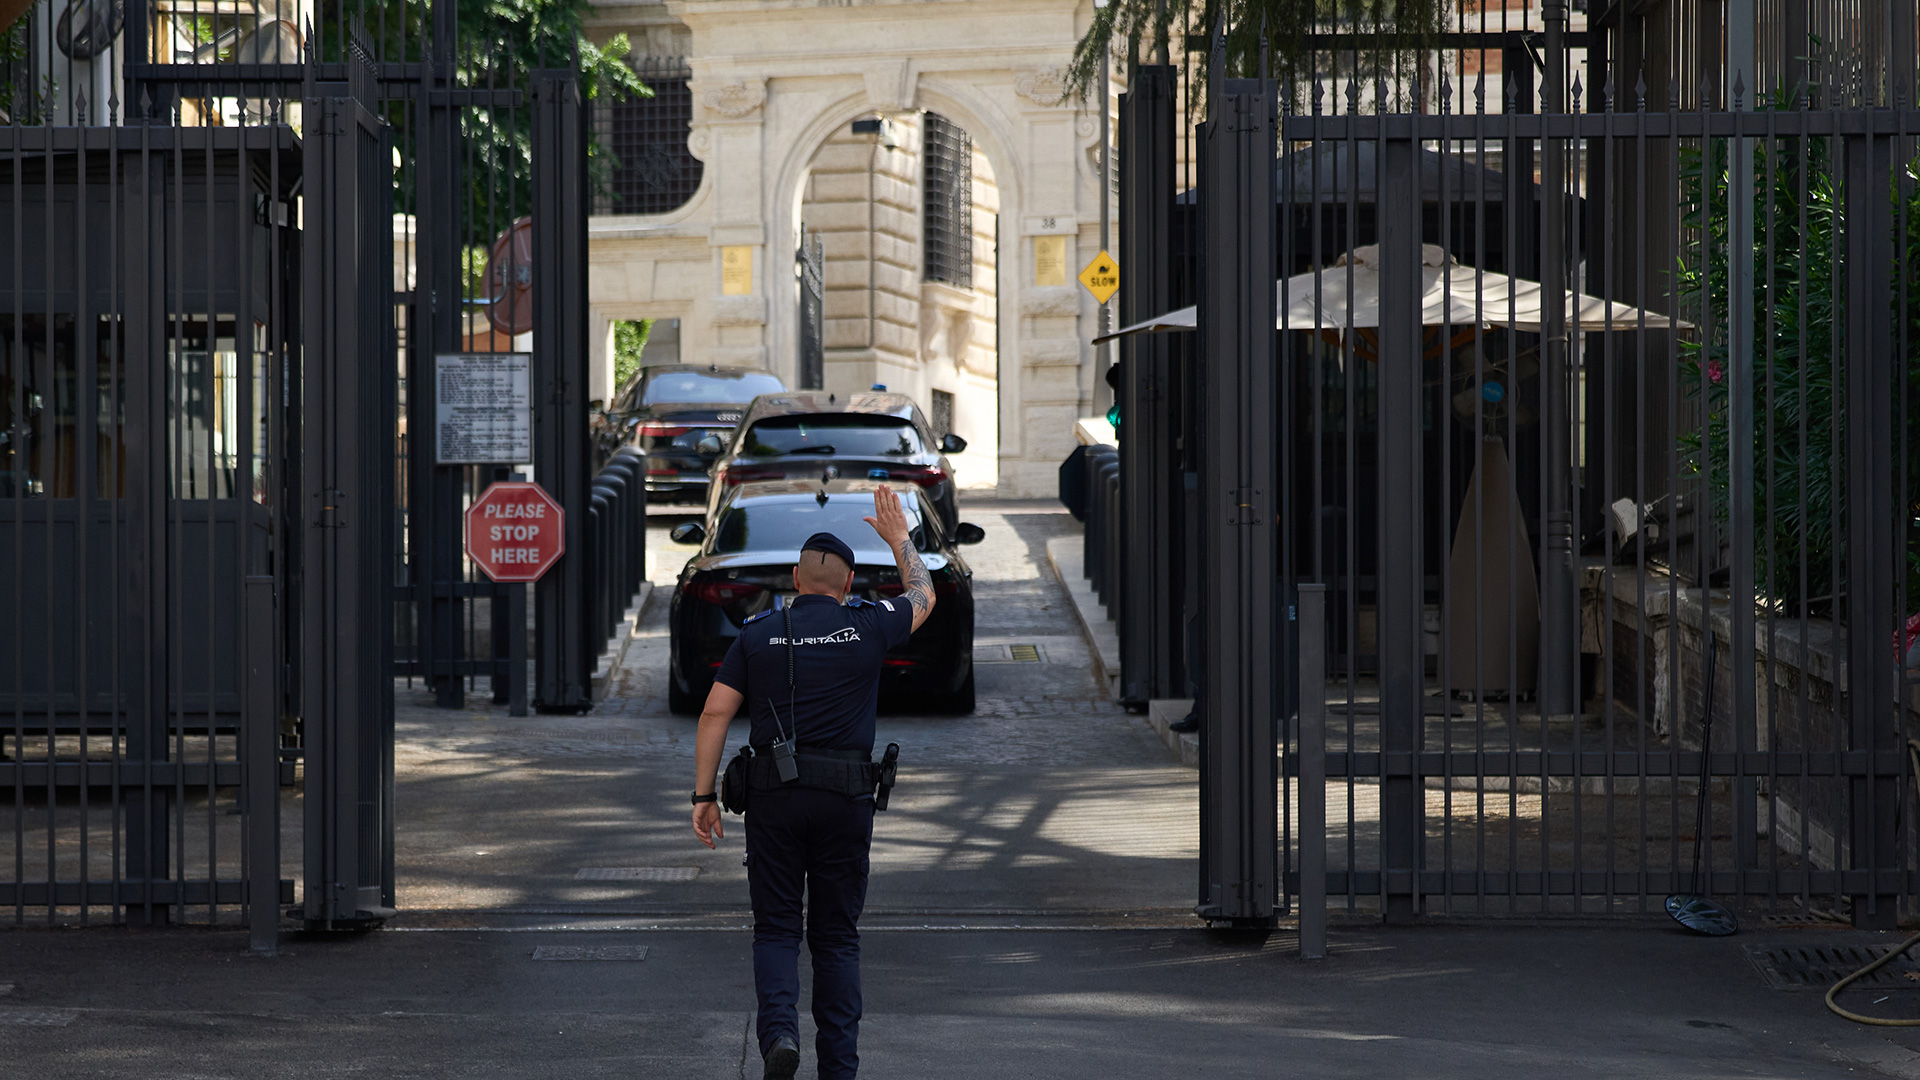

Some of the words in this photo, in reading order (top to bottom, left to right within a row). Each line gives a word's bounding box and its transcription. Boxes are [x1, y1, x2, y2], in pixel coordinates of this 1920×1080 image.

[1042, 218, 1056, 229] 38
[1090, 277, 1117, 287] SLOW
[484, 503, 546, 519] PLEASE
[490, 525, 540, 541] STOP
[490, 548, 540, 564] HERE
